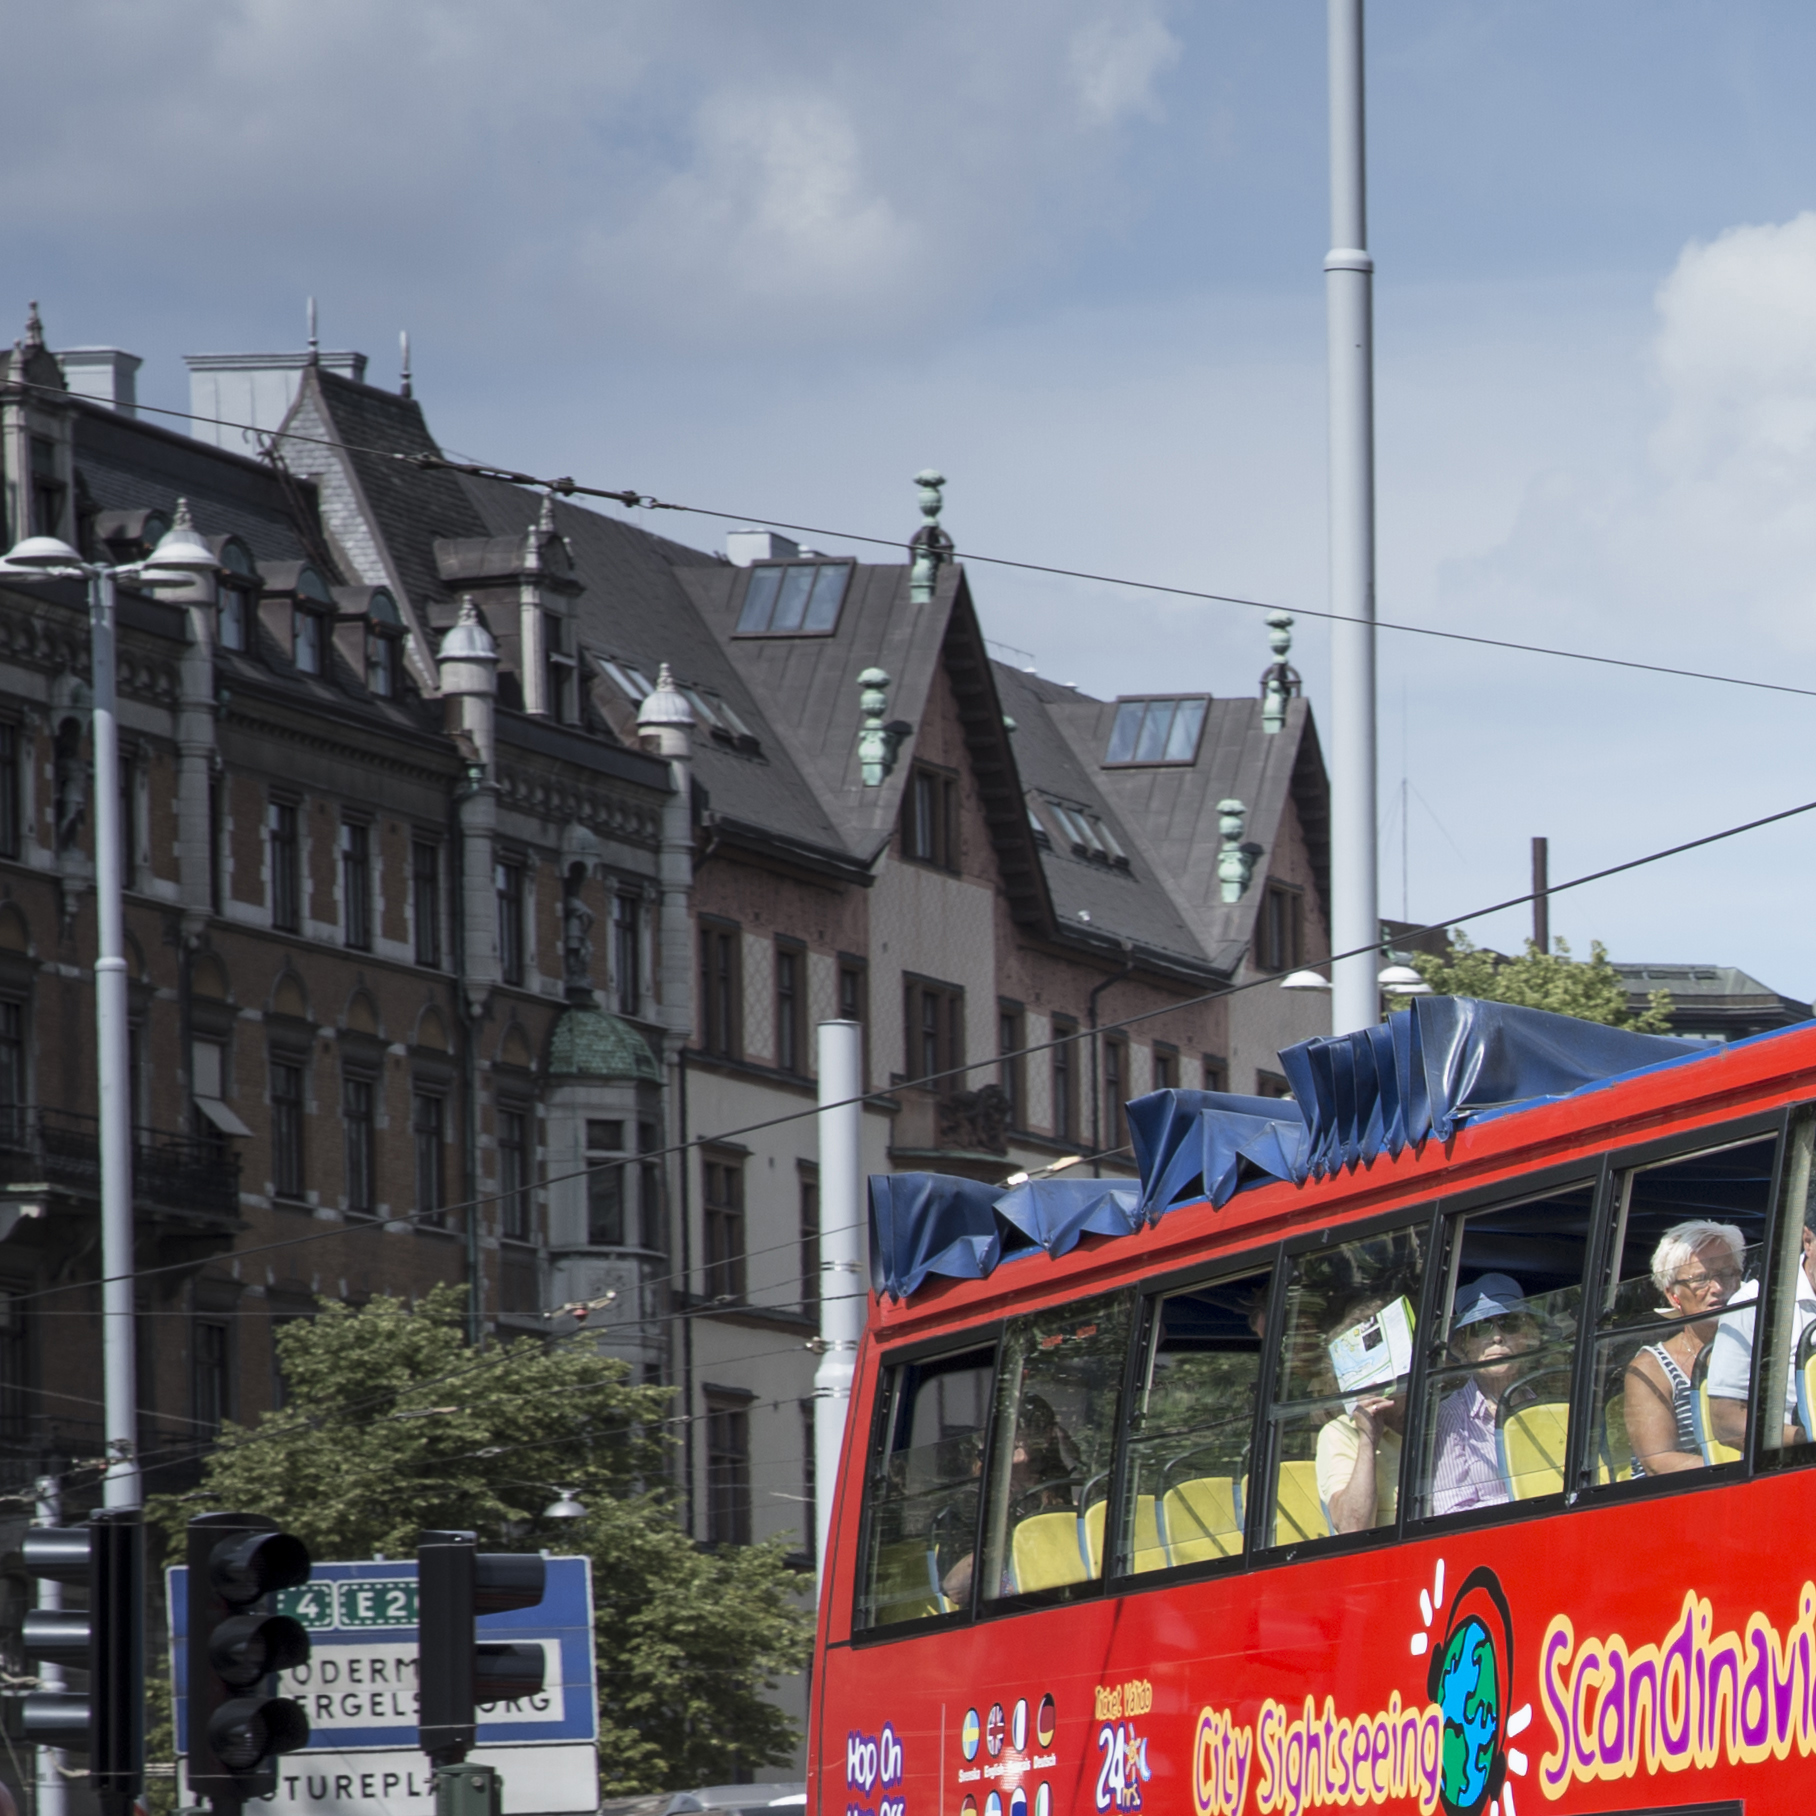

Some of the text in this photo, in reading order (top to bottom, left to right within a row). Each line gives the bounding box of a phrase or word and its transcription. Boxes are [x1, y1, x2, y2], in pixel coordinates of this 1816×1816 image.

[296, 1591, 419, 1619] 4 E 2
[1094, 1684, 1123, 1721] Ticket
[846, 1722, 903, 1797] Hop On
[1096, 1726, 1126, 1810] 24
